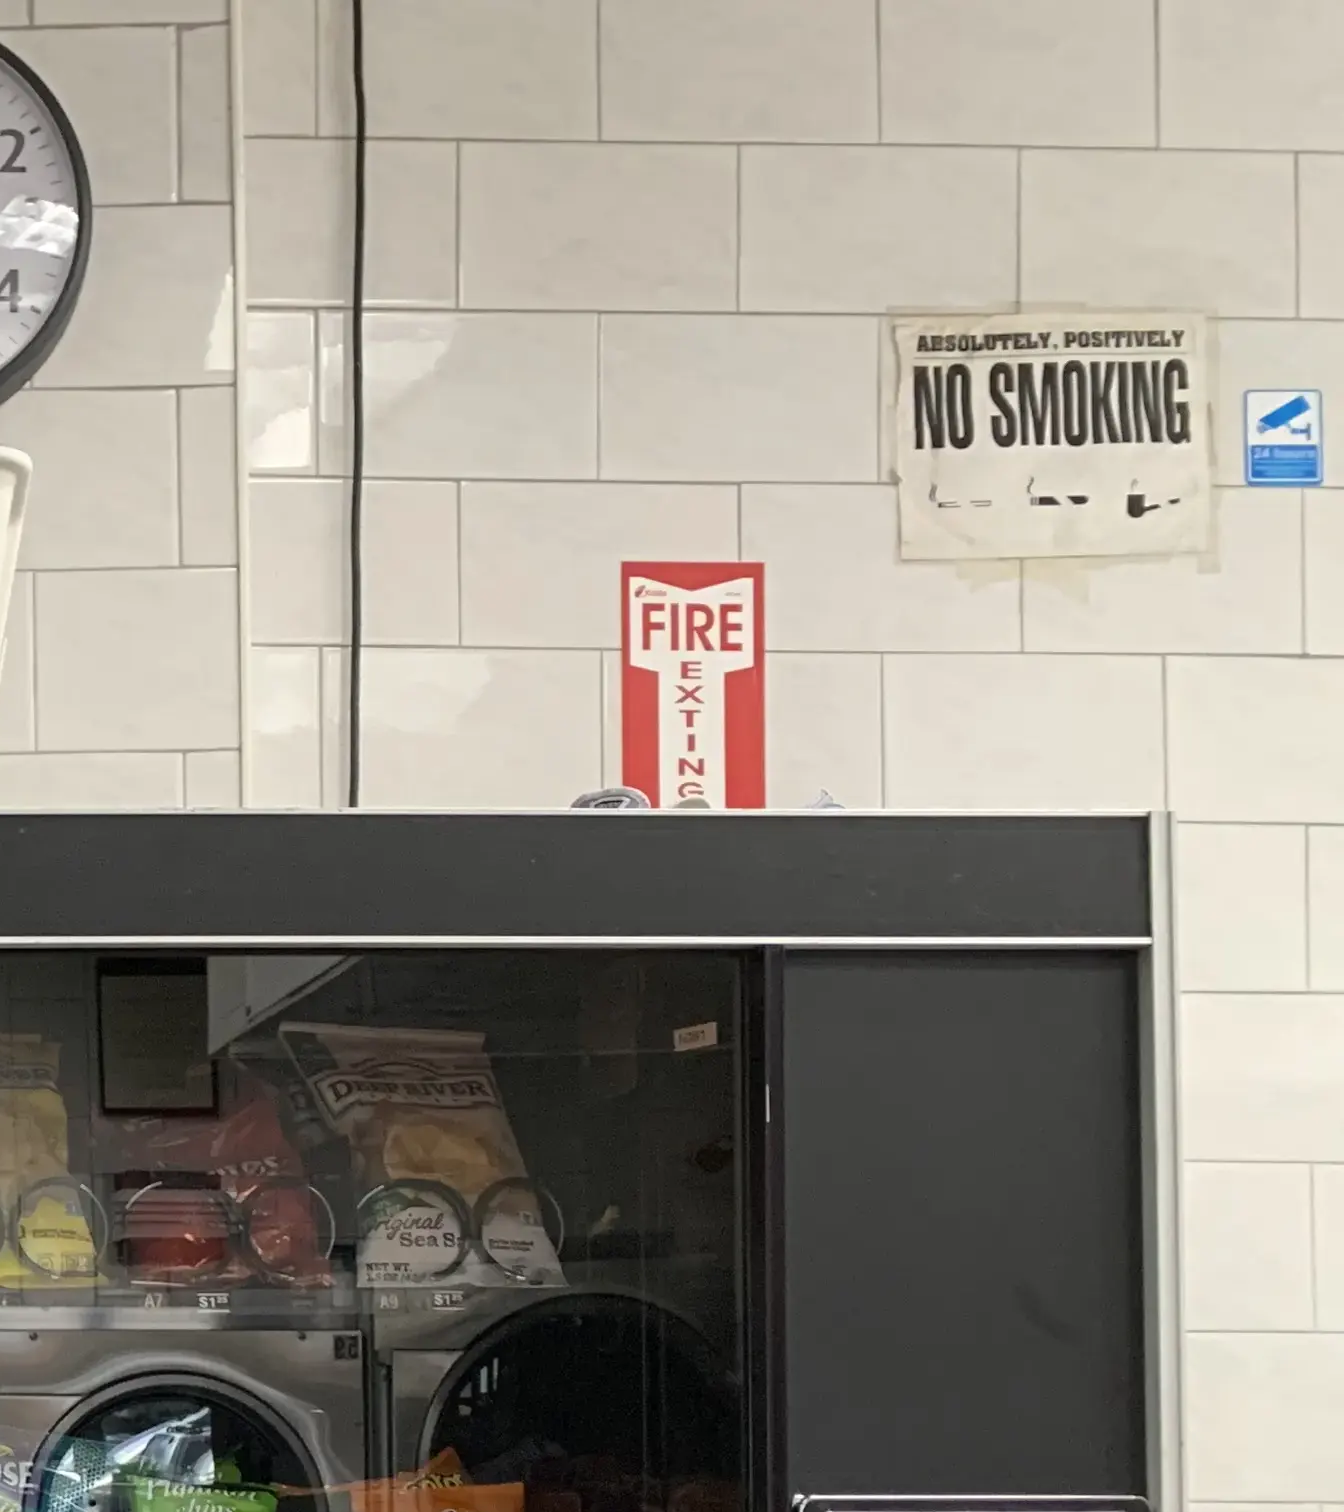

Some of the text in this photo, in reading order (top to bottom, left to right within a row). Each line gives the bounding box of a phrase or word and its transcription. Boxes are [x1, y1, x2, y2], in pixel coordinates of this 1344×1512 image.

[1063, 329, 1185, 349] POSITIVELY
[913, 358, 1192, 450] NO SMOKING
[642, 603, 743, 651] FIRE
[400, 1232, 439, 1247] Sea
